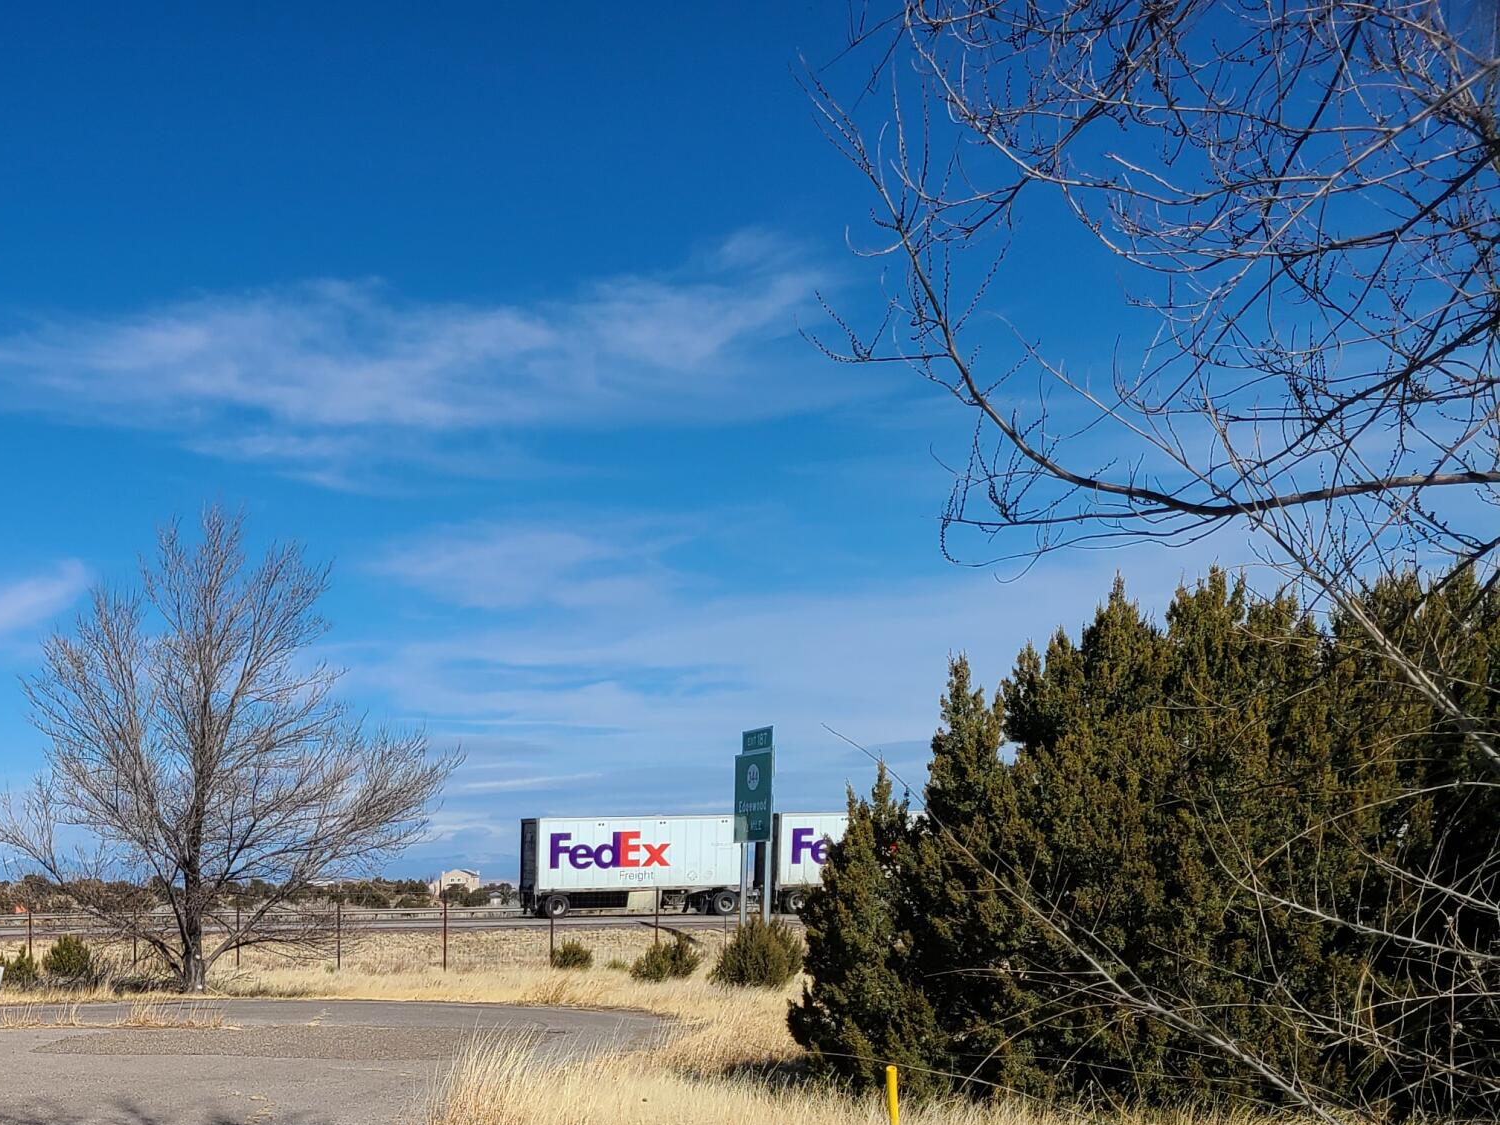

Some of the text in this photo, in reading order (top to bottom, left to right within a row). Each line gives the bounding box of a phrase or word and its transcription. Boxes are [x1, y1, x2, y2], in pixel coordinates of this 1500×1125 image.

[757, 733, 767, 746] 187
[739, 799, 767, 814] Edgewood
[549, 831, 671, 869] FedEx
[791, 827, 828, 865] Fe
[619, 870, 654, 882] Freight
